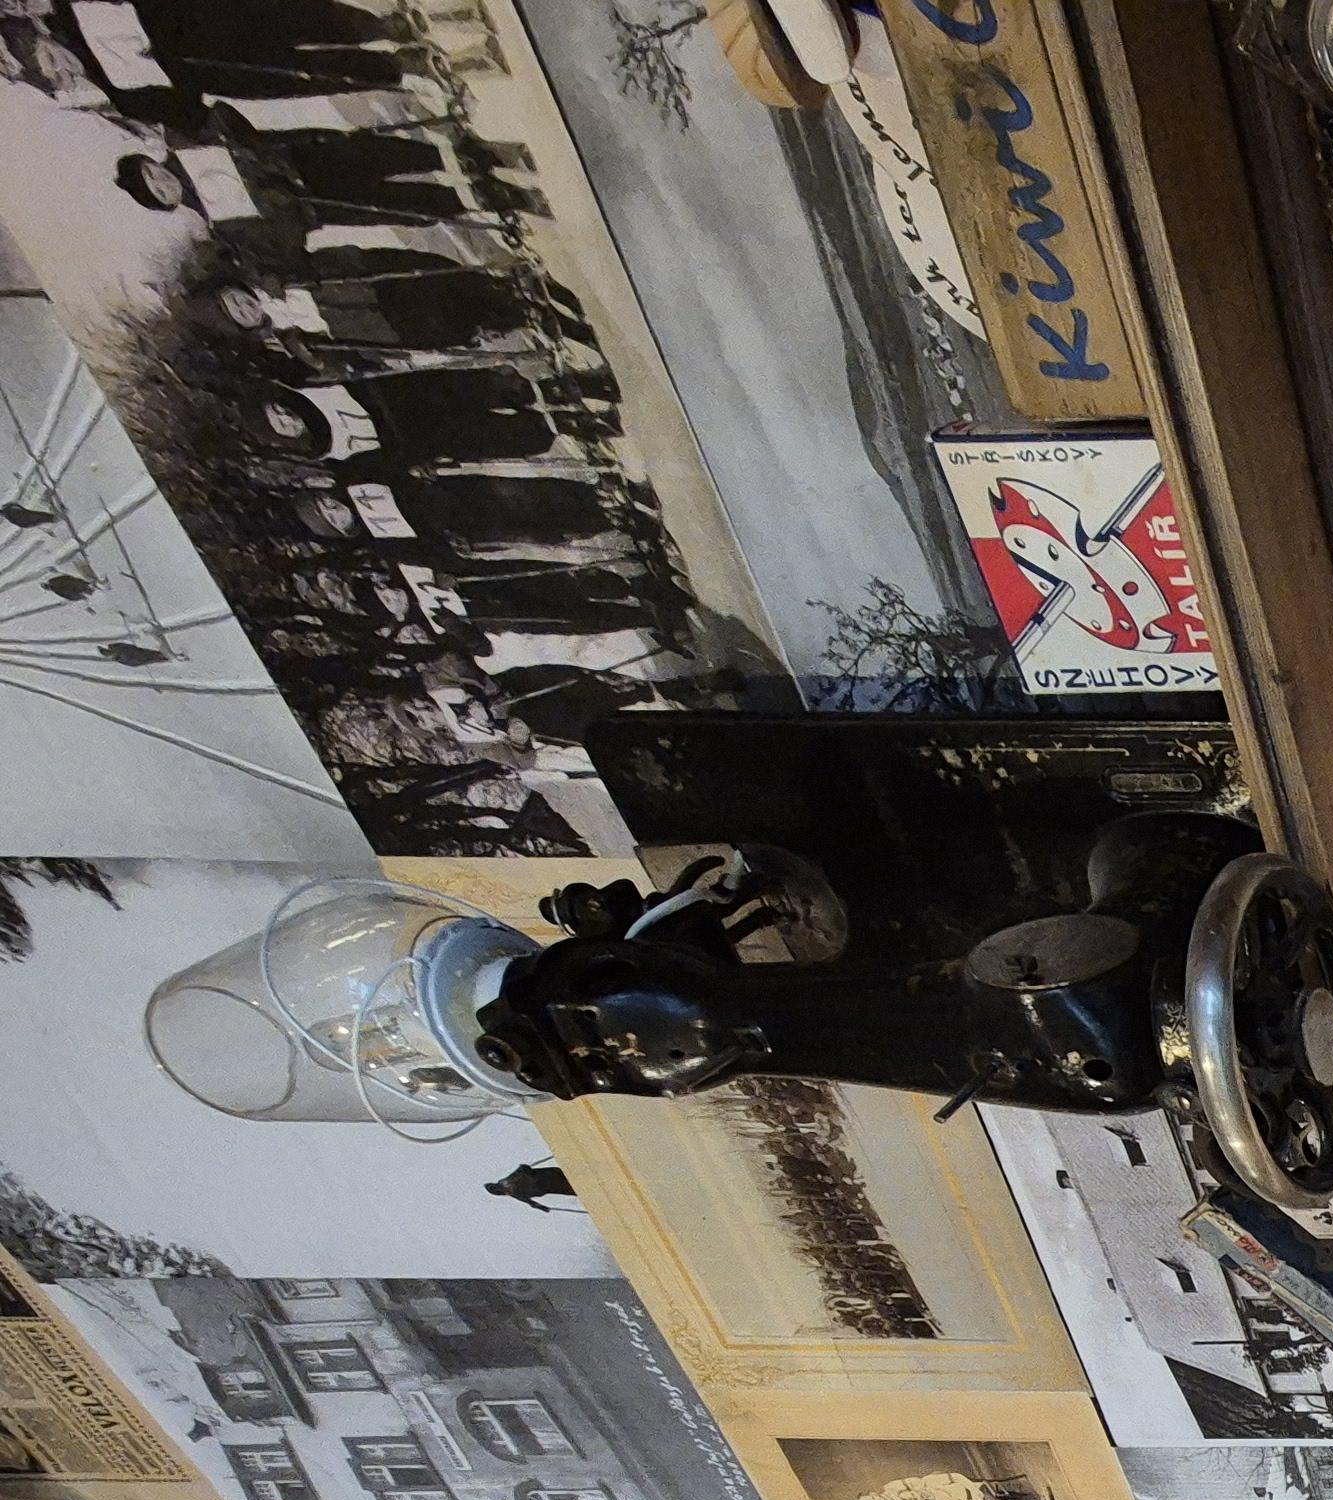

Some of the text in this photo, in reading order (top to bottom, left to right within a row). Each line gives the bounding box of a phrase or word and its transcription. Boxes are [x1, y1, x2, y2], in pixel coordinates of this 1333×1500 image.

[950, 58, 1111, 383] Kiwi
[1145, 514, 1208, 648] TALÍŘ
[58, 1373, 120, 1430] VELOX
